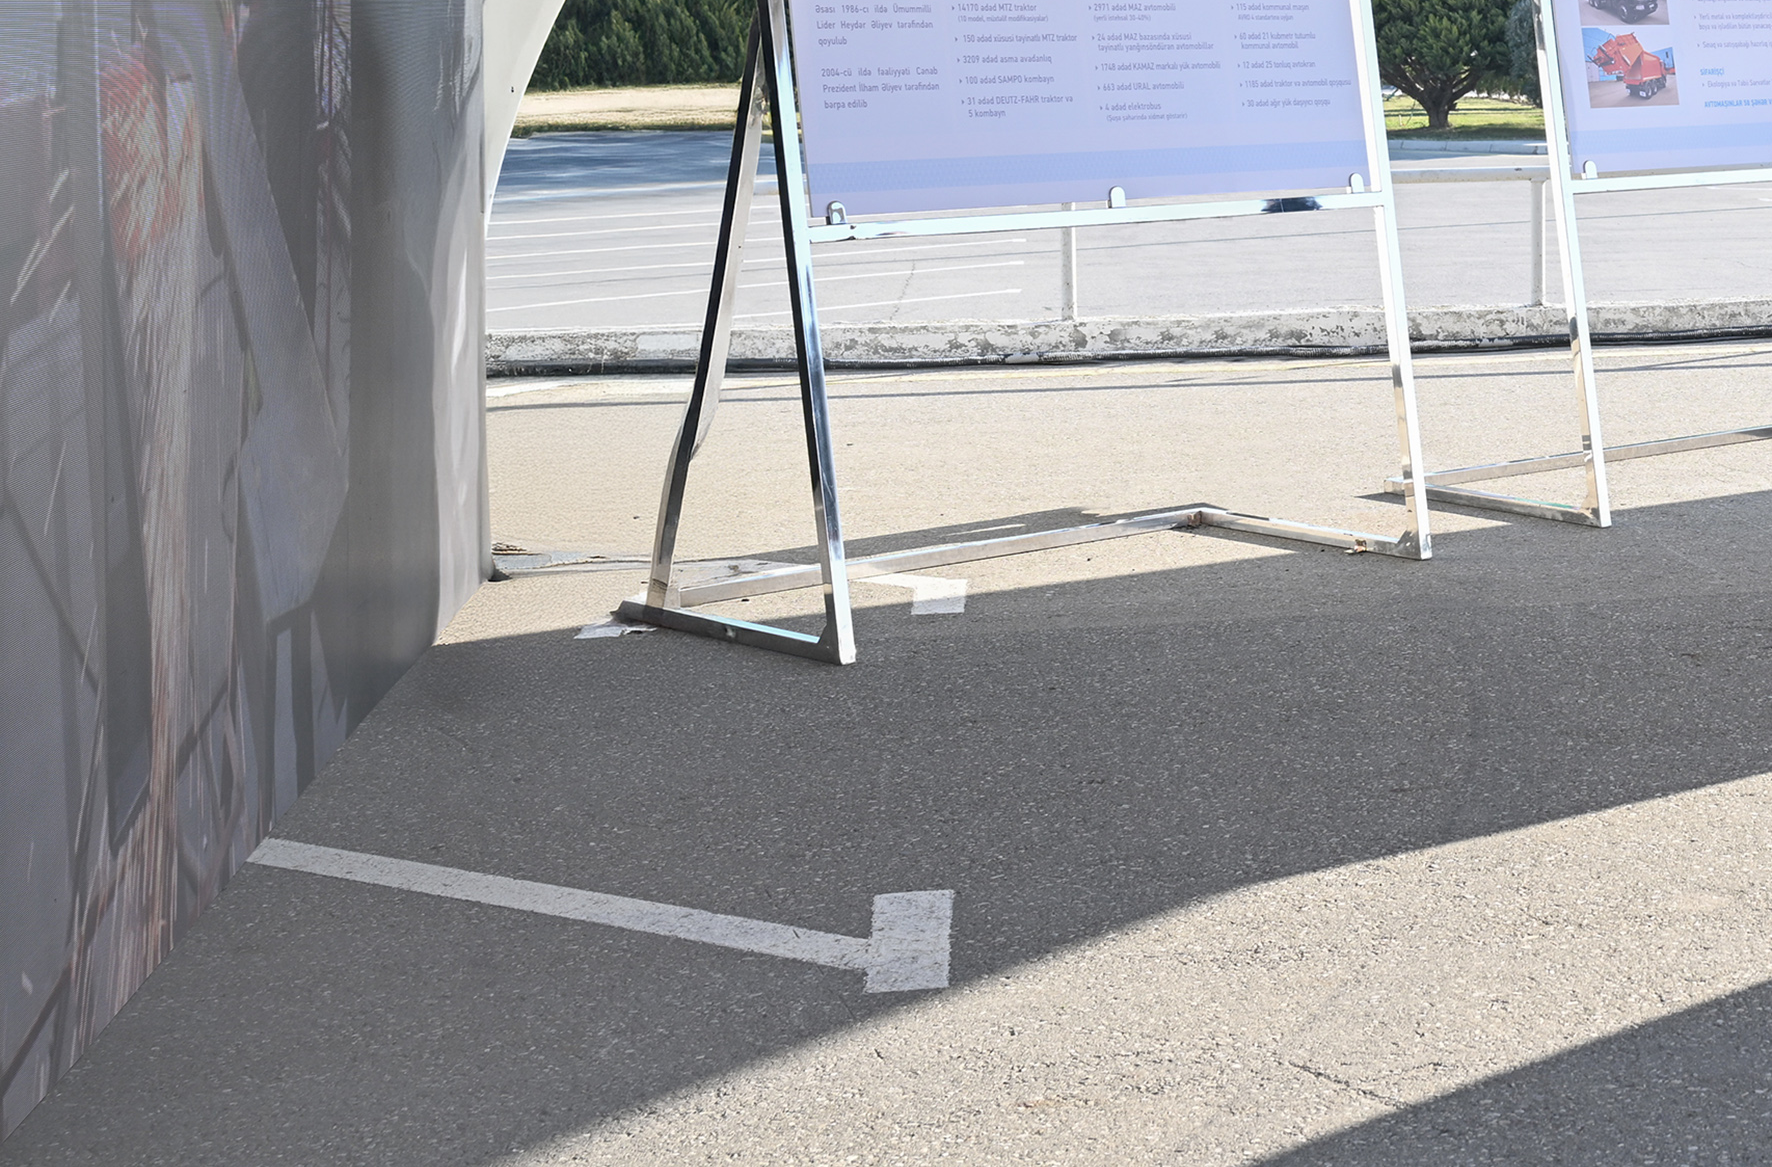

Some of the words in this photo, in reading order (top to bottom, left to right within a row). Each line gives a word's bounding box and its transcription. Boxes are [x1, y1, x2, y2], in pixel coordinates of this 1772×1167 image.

[814, 4, 835, 13] Əsası
[841, 4, 869, 13] 1986-cı
[874, 4, 888, 13] ildə
[892, 3, 931, 13] Ümummilli
[957, 3, 978, 11] 14170
[980, 3, 996, 11] ədəd
[998, 3, 1012, 11] MTZ
[1013, 3, 1036, 11] traktor
[1128, 3, 1142, 11] MAZ
[816, 20, 835, 29] Lider
[840, 20, 866, 31] Heydər
[870, 20, 892, 30] Əliyev
[896, 19, 933, 28] tərəfindən
[962, 34, 975, 43] 150
[976, 34, 992, 42] ədəd
[993, 34, 1014, 42] xüsusi
[1015, 33, 1040, 43] təyinatlı
[1041, 33, 1055, 41] MTZ
[1055, 33, 1077, 41] traktor
[1123, 32, 1137, 40] MAZ
[818, 36, 847, 47] qoyulub
[962, 54, 980, 63] 3209
[981, 54, 998, 63] ədəd
[1019, 53, 1052, 64] avadanlıq
[1132, 61, 1154, 70] KAMAZ
[820, 67, 852, 77] 2004-cü
[858, 67, 872, 76] ildə
[877, 66, 910, 77] fəaliyyəti
[915, 66, 938, 75] Cənab
[965, 75, 978, 84] 100
[979, 75, 996, 84] ədəd
[997, 74, 1022, 83] SAMPO
[1023, 74, 1054, 84] kombayn
[822, 83, 856, 93] Prezident
[858, 83, 879, 92] İlham
[881, 82, 902, 93] Əliyev
[904, 81, 939, 91] tərəfindən
[1132, 82, 1150, 90] URAL
[824, 99, 846, 110] bərpa
[847, 99, 868, 108] edilib
[967, 96, 975, 105] 31
[977, 96, 994, 105] ədəd
[995, 94, 1039, 104] DEUTZ-FAHR
[1040, 94, 1063, 103] traktor
[1104, 103, 1110, 111] 4
[968, 109, 973, 117] 5
[974, 108, 1006, 118] kombayn
